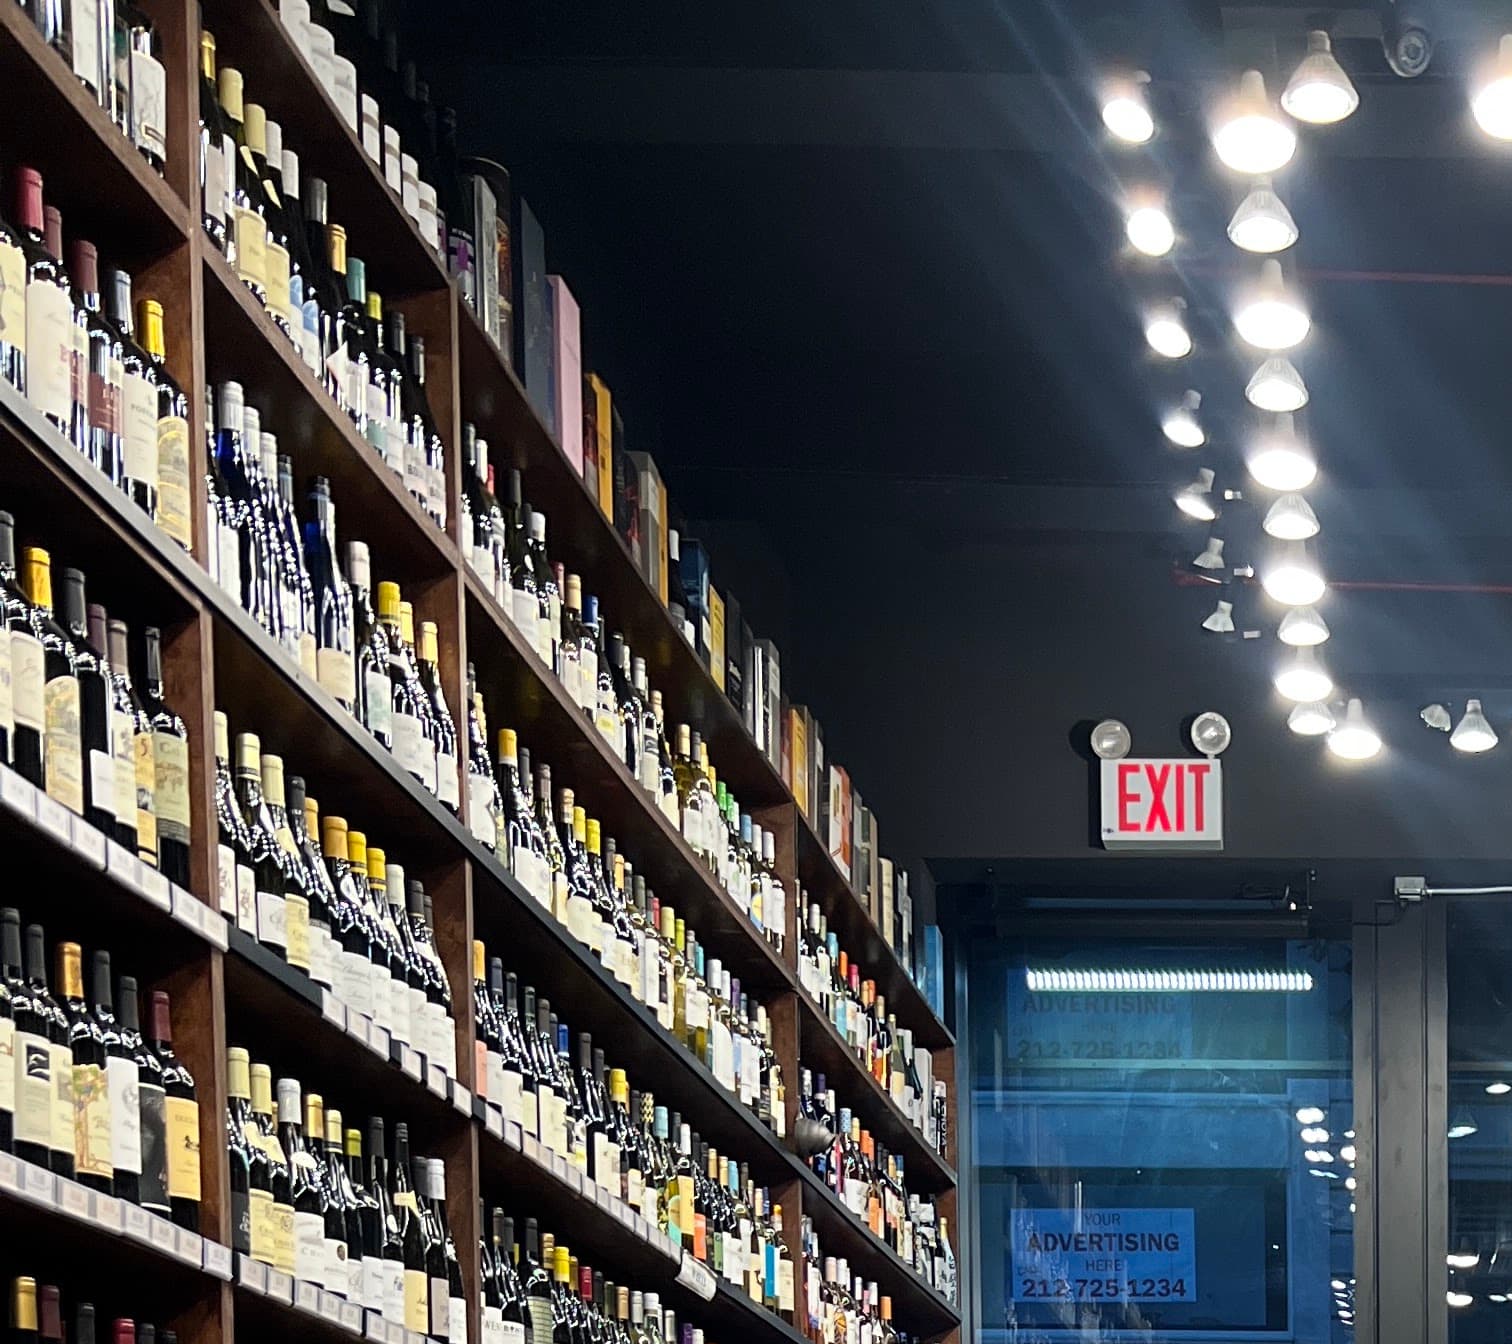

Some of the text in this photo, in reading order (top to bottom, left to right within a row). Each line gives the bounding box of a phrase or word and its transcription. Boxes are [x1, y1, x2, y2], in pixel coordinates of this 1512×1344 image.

[1118, 764, 1210, 832] EXIT
[1084, 1213, 1121, 1226] YOUR
[1028, 1233, 1179, 1252] ADVERTISING
[1085, 1260, 1122, 1272] HERE
[1022, 1279, 1187, 1298] 212-725-1234
